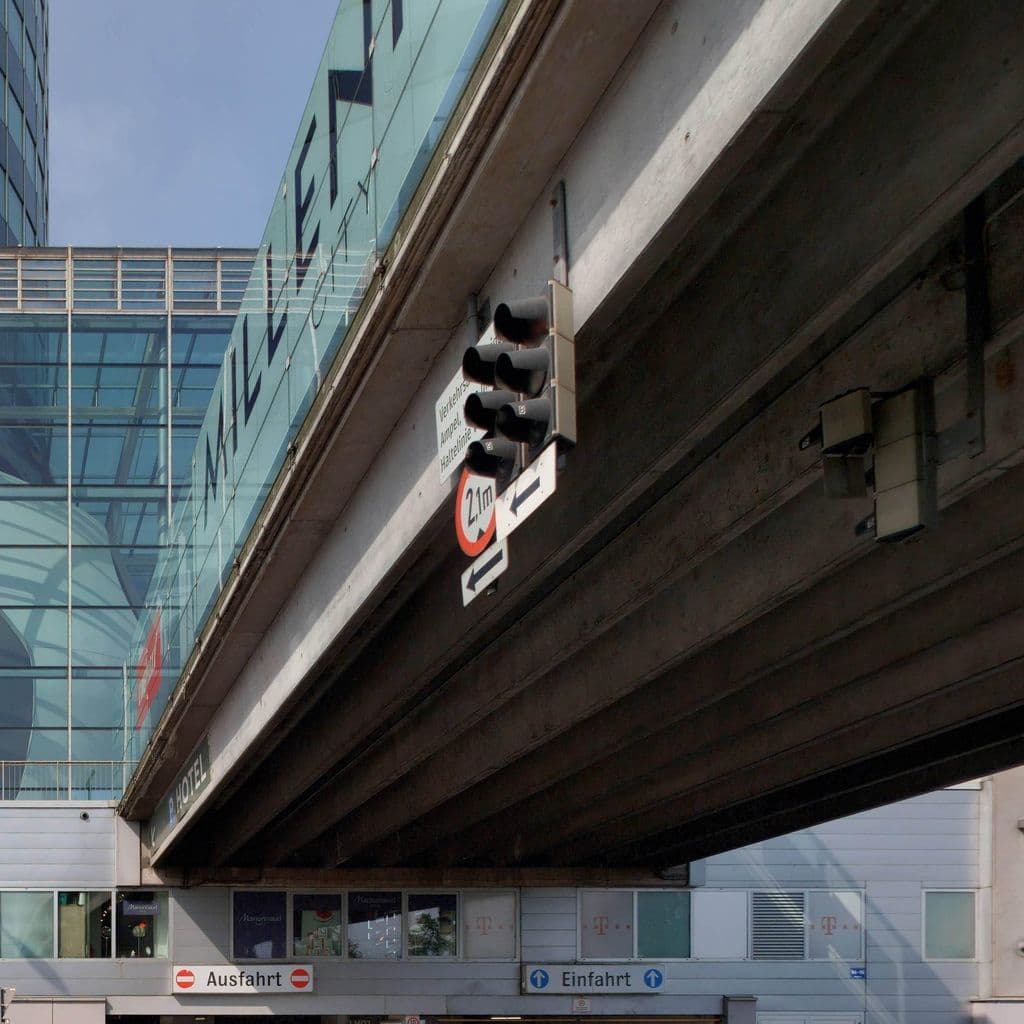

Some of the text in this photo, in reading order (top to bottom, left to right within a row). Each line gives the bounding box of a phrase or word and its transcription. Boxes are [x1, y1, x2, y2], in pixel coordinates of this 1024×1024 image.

[204, 0, 404, 531] MILLEN
[309, 181, 370, 329] CITY
[440, 379, 471, 422] Verkehrs
[440, 410, 462, 448] Ampel,
[440, 427, 473, 473] Haltelinie
[176, 753, 207, 813] HOTEL
[207, 971, 282, 986] Ausfahrt
[562, 971, 632, 987] Einfahrt
